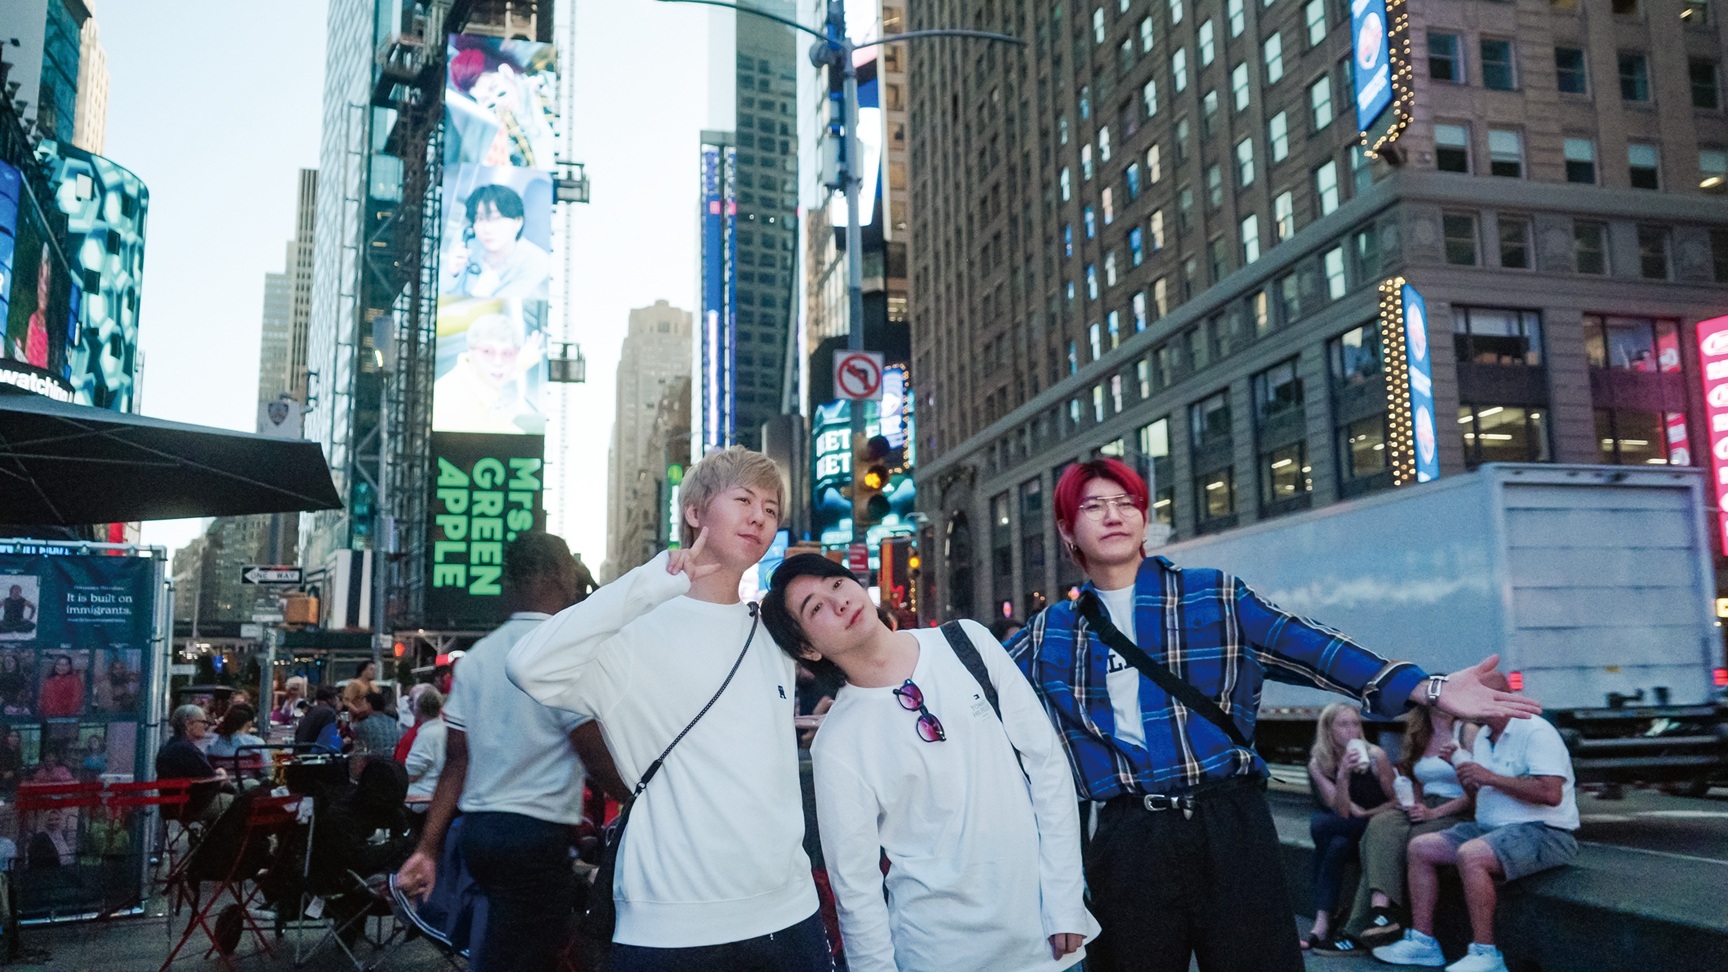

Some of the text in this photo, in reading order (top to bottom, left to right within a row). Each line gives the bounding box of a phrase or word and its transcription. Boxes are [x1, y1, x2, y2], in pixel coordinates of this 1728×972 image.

[433, 456, 470, 588] APPLE
[469, 457, 506, 595] GREEN
[506, 458, 541, 542] Mrs.
[66, 593, 133, 604] It is built on
[66, 605, 132, 616] immigrants.
